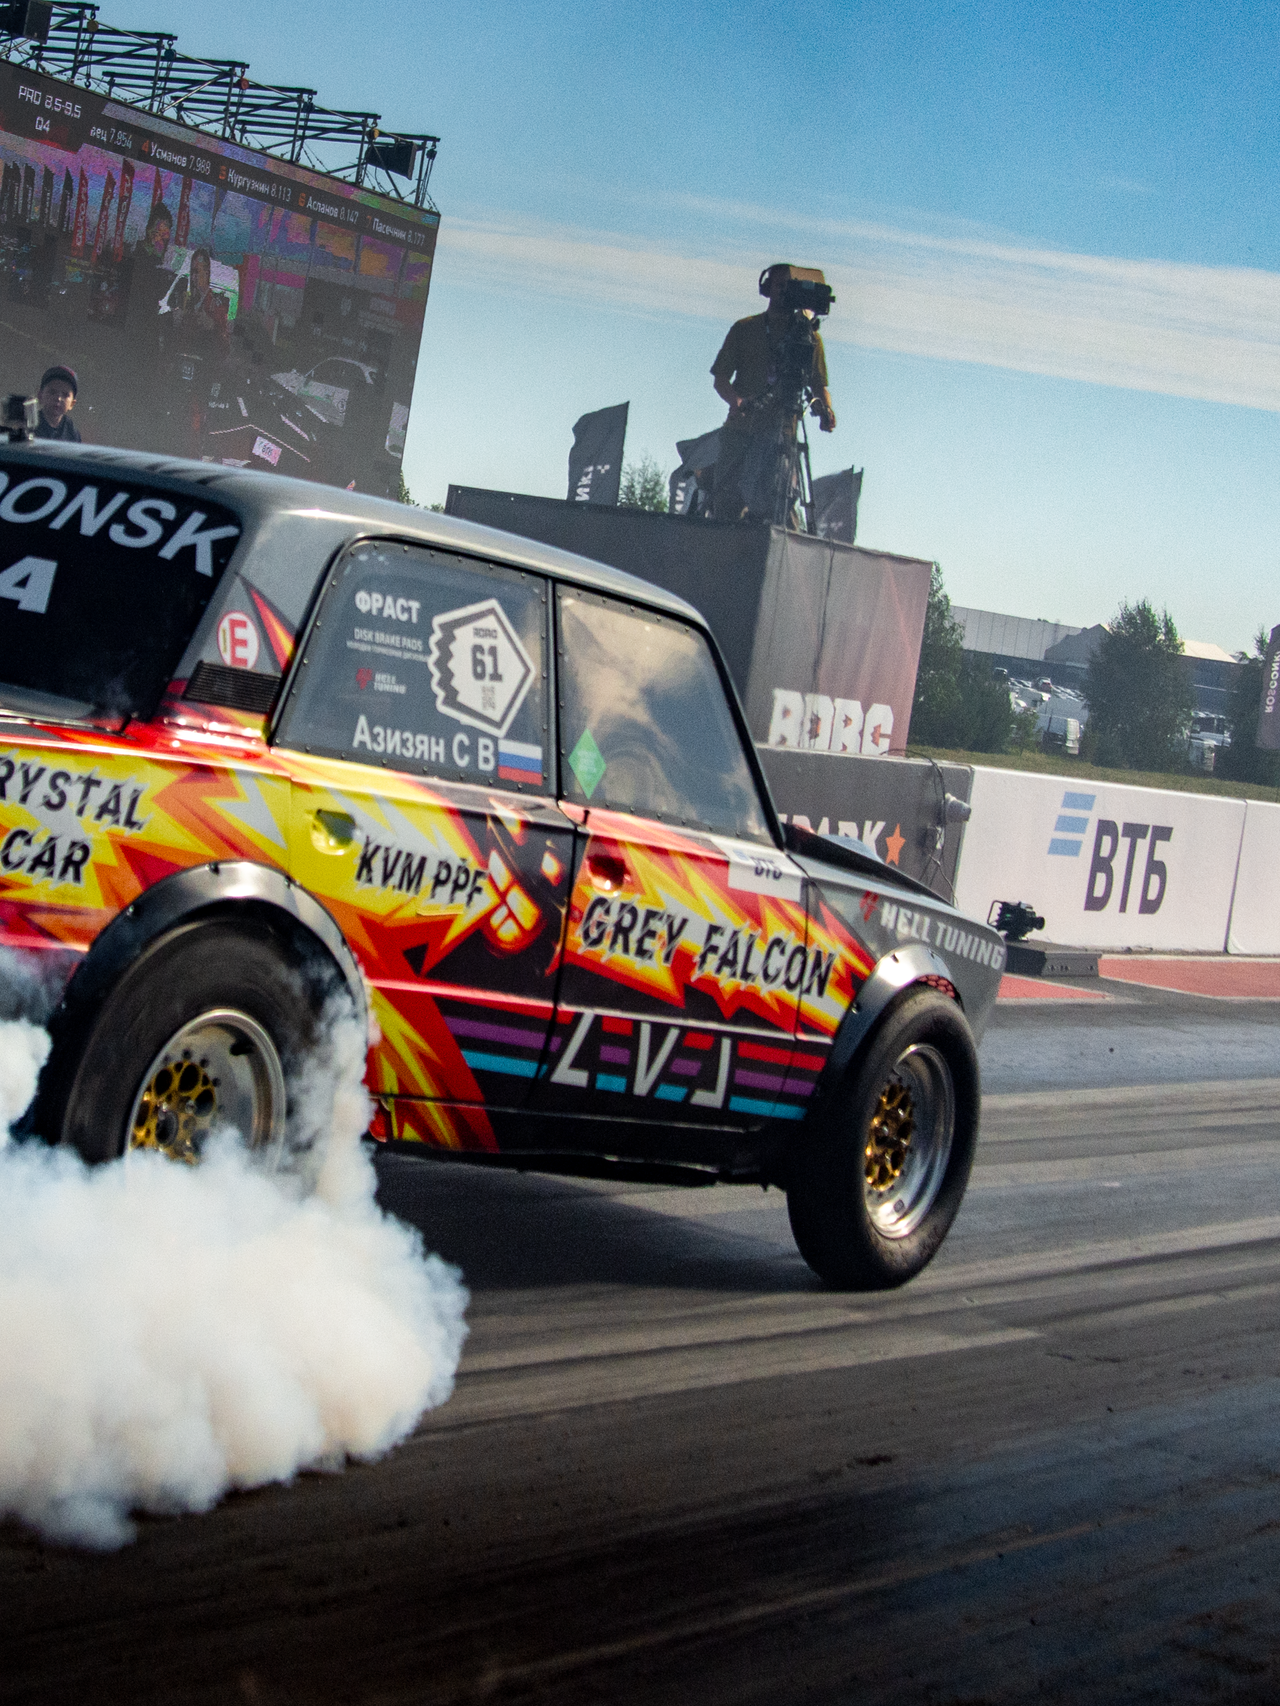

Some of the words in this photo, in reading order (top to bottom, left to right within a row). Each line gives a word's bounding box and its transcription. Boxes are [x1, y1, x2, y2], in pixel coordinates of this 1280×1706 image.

[18, 85, 42, 105] PRO
[35, 116, 51, 134] Q4
[141, 139, 150, 154] 4
[150, 141, 187, 167] Усманов
[218, 165, 227, 180] 5
[270, 183, 292, 201] 8.113
[298, 192, 307, 207] 6
[306, 196, 339, 218] Асланов
[355, 591, 421, 624] ФРАСТ
[228, 618, 248, 668] E
[471, 644, 503, 682] 61
[0, 827, 91, 885] CAR
[1084, 818, 1174, 916] ВТБ
[430, 857, 487, 908] PPF
[582, 897, 687, 967] GREY
[697, 922, 833, 999] FALCON
[880, 901, 932, 944] HELL
[935, 921, 1007, 970] TUNING
